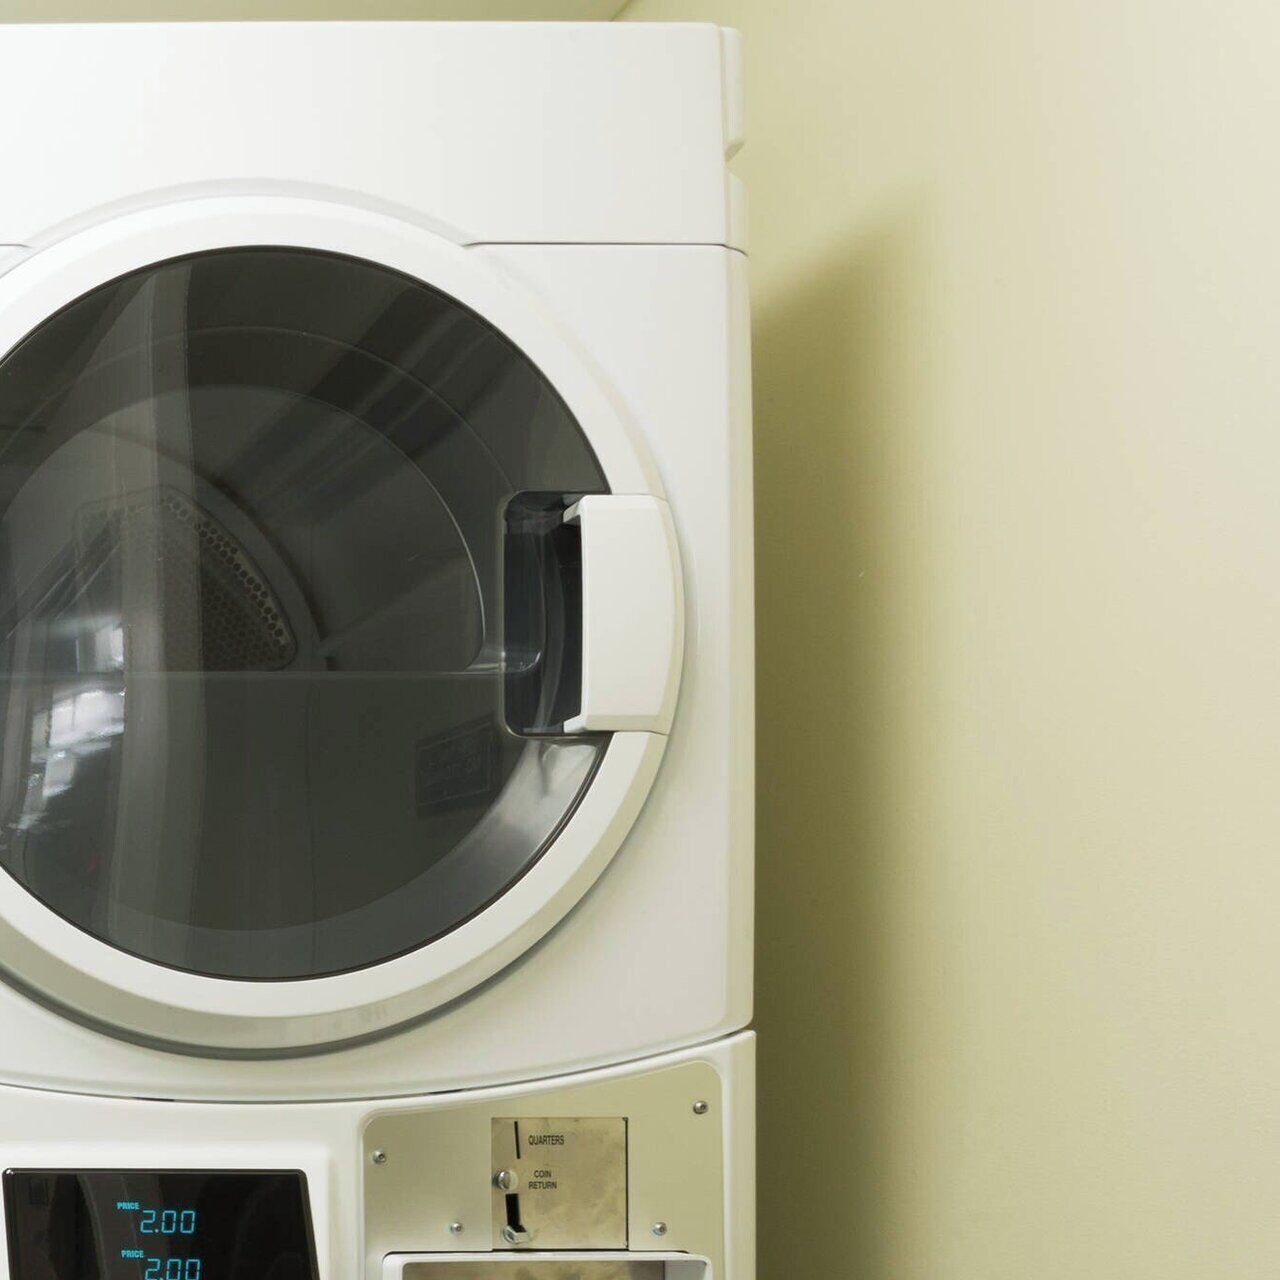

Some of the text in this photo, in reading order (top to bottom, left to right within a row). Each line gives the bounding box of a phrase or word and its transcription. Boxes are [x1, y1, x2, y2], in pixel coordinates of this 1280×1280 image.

[528, 1134, 564, 1145] QUARTERS
[534, 1169, 552, 1178] COIN
[528, 1181, 557, 1189] RETURN
[116, 1202, 140, 1210] PRICE
[140, 1210, 195, 1234] 2.00
[121, 1250, 144, 1258] PRICE
